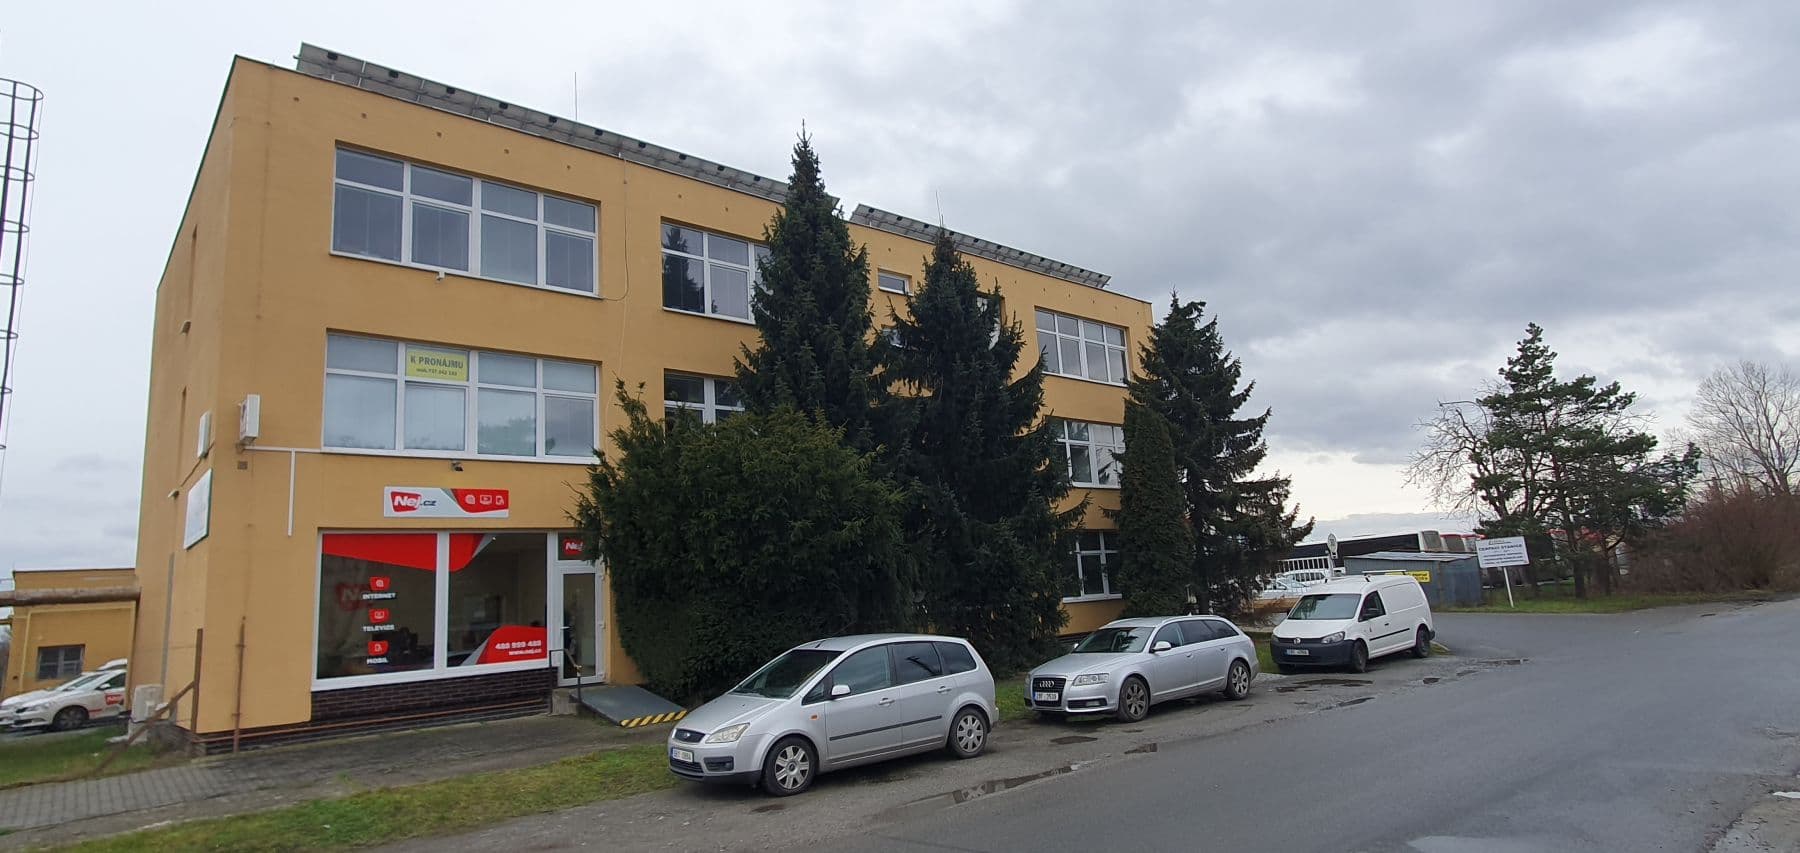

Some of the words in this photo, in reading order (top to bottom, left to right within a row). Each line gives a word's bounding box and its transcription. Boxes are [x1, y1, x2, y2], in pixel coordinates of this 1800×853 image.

[410, 355, 416, 365] K
[418, 356, 464, 369] PRONÁJMU
[394, 494, 437, 510] Nej.cz
[362, 592, 397, 600] INTERNET
[366, 657, 389, 665] MOBIL
